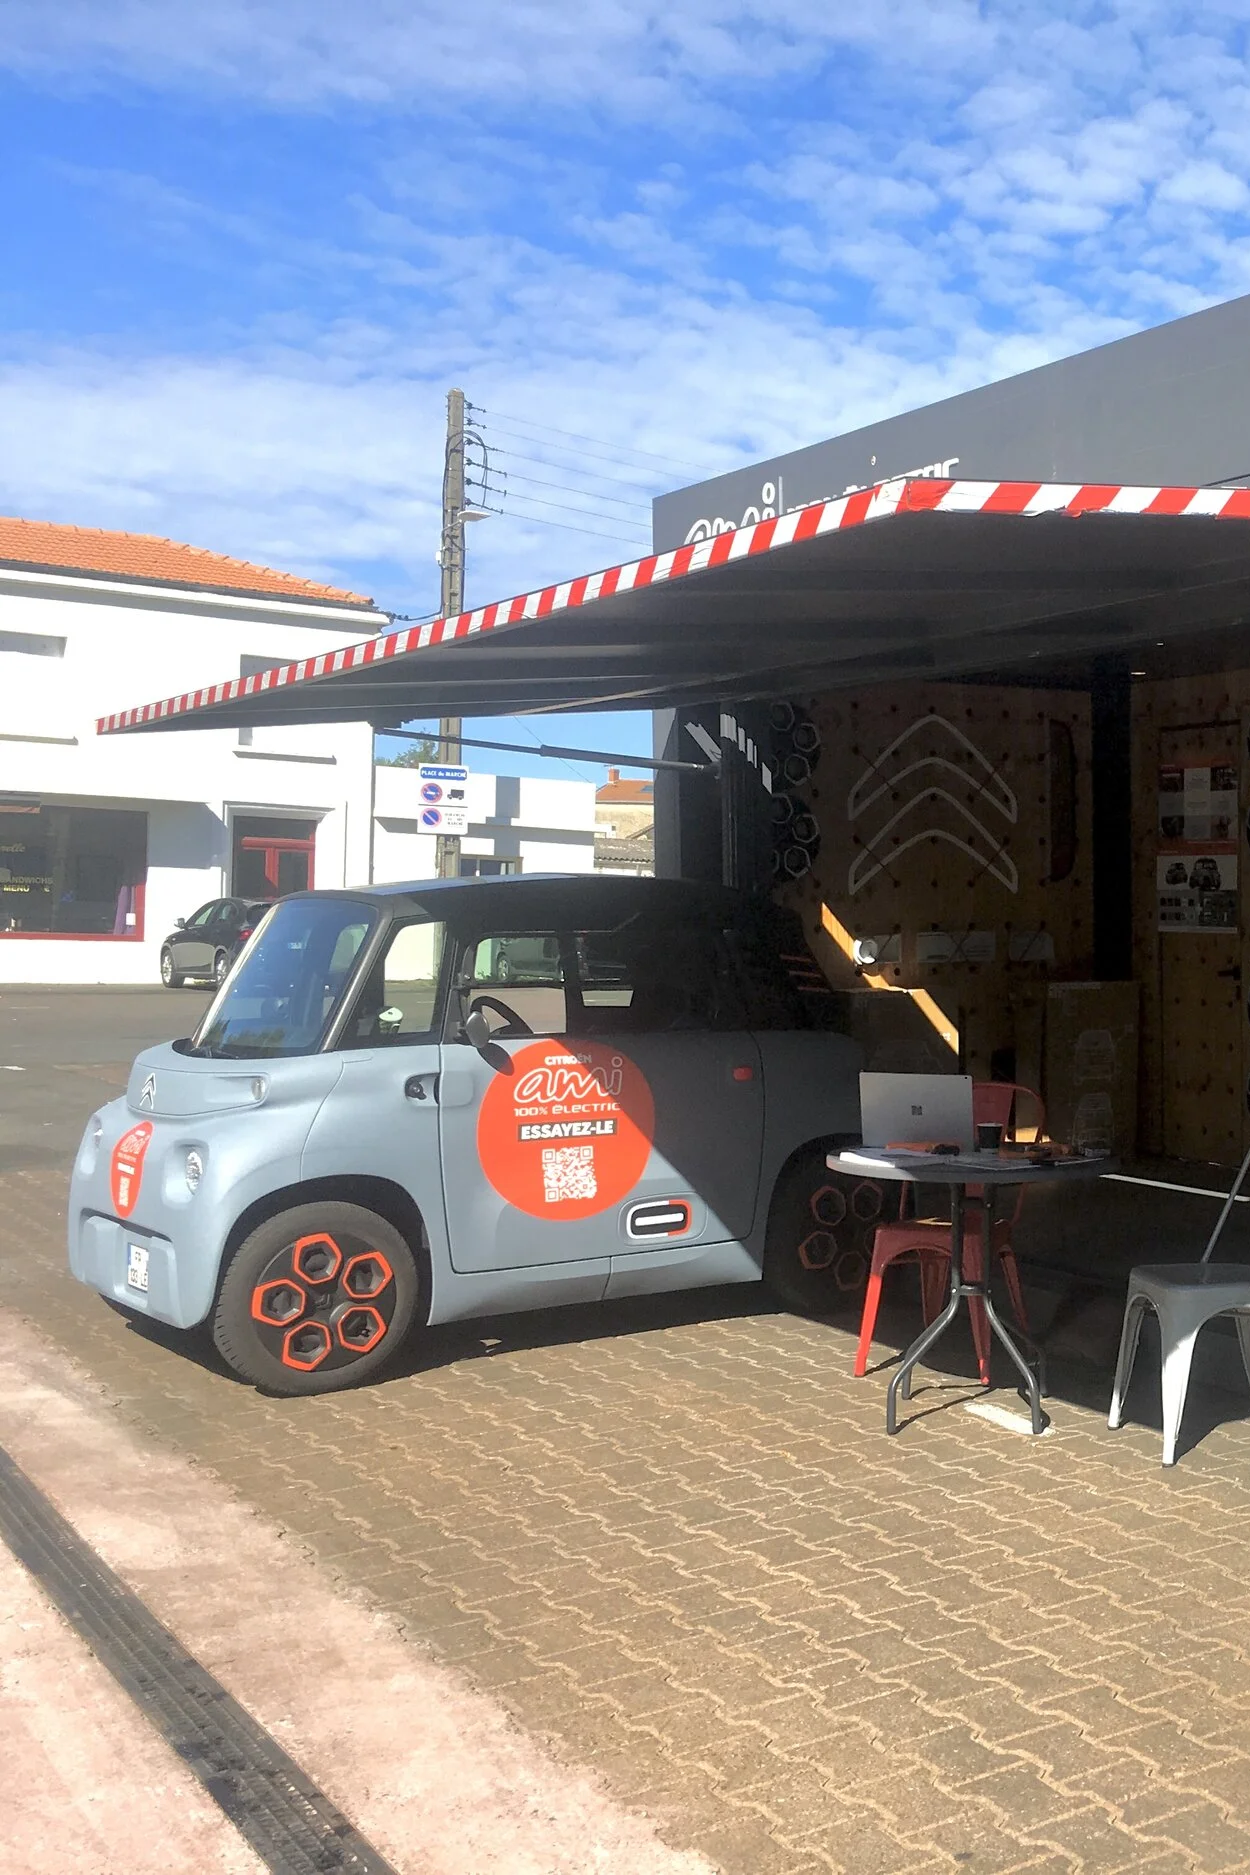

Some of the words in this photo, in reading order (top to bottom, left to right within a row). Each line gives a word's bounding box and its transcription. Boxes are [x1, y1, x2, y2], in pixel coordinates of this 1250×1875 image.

[513, 1056, 623, 1104] ami
[513, 1107, 548, 1117] 100%
[521, 1120, 614, 1140] ESSAYEZ-LE
